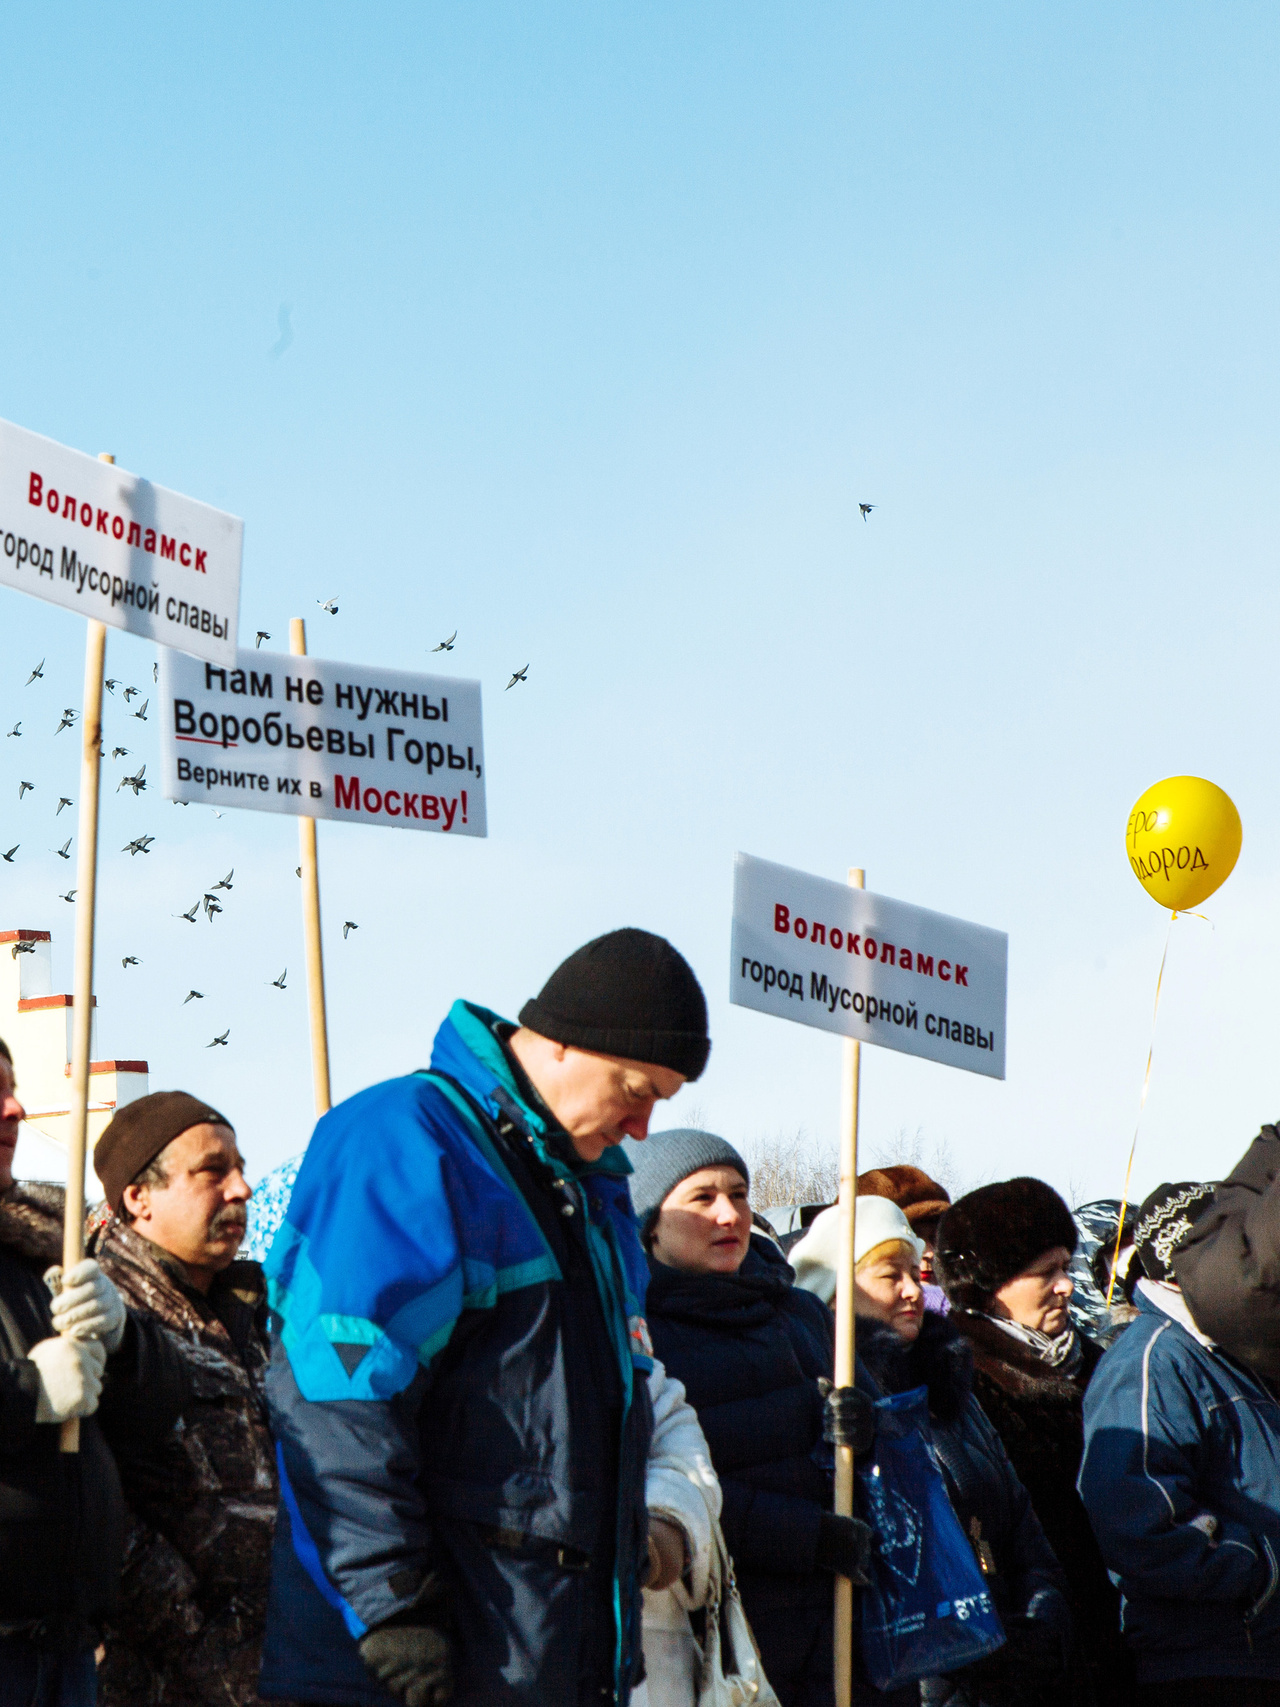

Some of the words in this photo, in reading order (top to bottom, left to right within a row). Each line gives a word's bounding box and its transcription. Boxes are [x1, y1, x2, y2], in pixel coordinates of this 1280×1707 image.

[28, 471, 208, 574] Волоколамск
[60, 545, 160, 616] Мусорной
[166, 597, 229, 641] славы
[205, 662, 273, 699] Нам
[285, 676, 324, 705] не
[335, 682, 449, 722] нужны
[174, 698, 375, 759] Воробьевы
[387, 728, 482, 779] Горы,
[177, 758, 269, 791] Верните
[277, 776, 302, 797] их
[310, 781, 323, 799] в
[334, 774, 468, 832] Москву!
[774, 903, 969, 987] Волоколамск
[741, 957, 804, 1001] город
[810, 971, 918, 1030] Мусорной
[925, 1013, 994, 1052] славы
